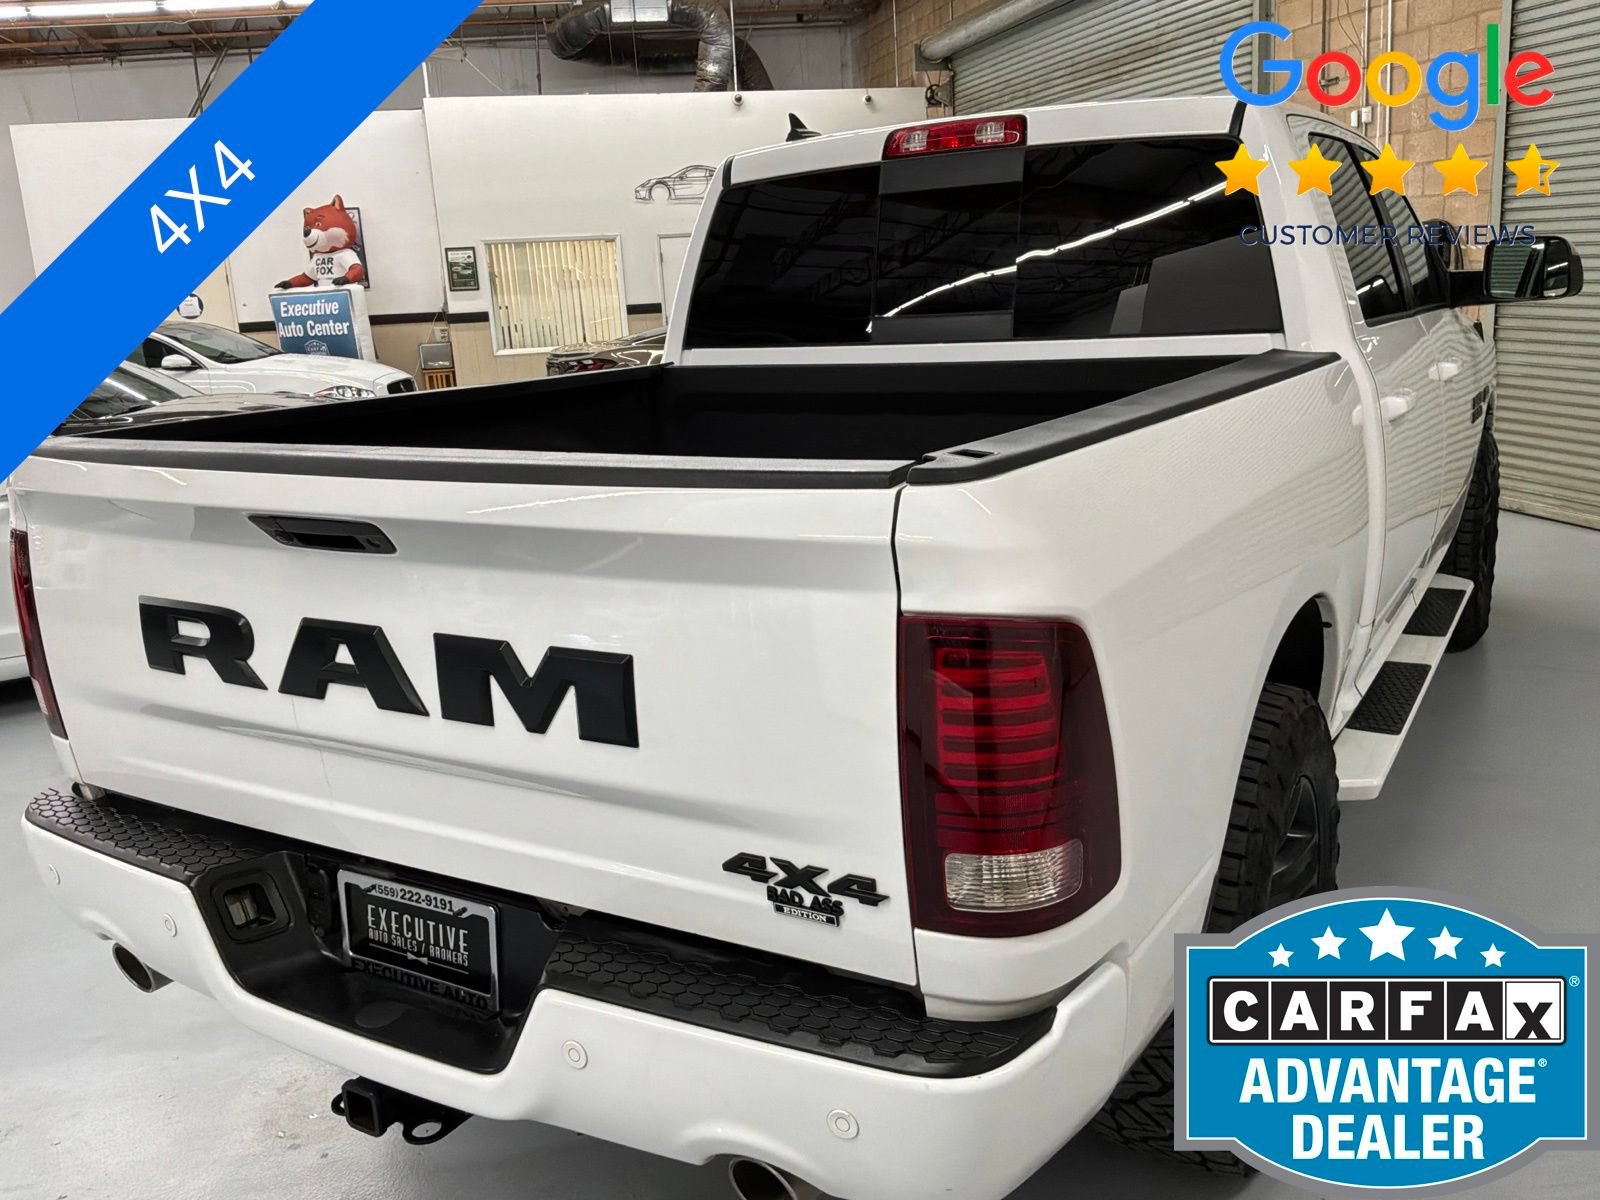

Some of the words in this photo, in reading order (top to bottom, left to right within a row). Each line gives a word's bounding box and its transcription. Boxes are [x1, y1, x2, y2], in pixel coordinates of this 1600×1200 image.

[315, 257, 335, 266] CAR
[315, 266, 335, 276] FOX
[280, 299, 339, 318] Executive
[278, 321, 304, 338] Auto
[306, 319, 350, 337] Center
[138, 595, 640, 748] RAM
[766, 885, 805, 907] BAD
[809, 895, 846, 917] ASS
[783, 906, 827, 923] EDITION
[367, 903, 469, 955] EXECUTIVE
[368, 928, 389, 944] AUTO
[391, 934, 418, 952] SALES
[429, 945, 470, 968] BROKERS
